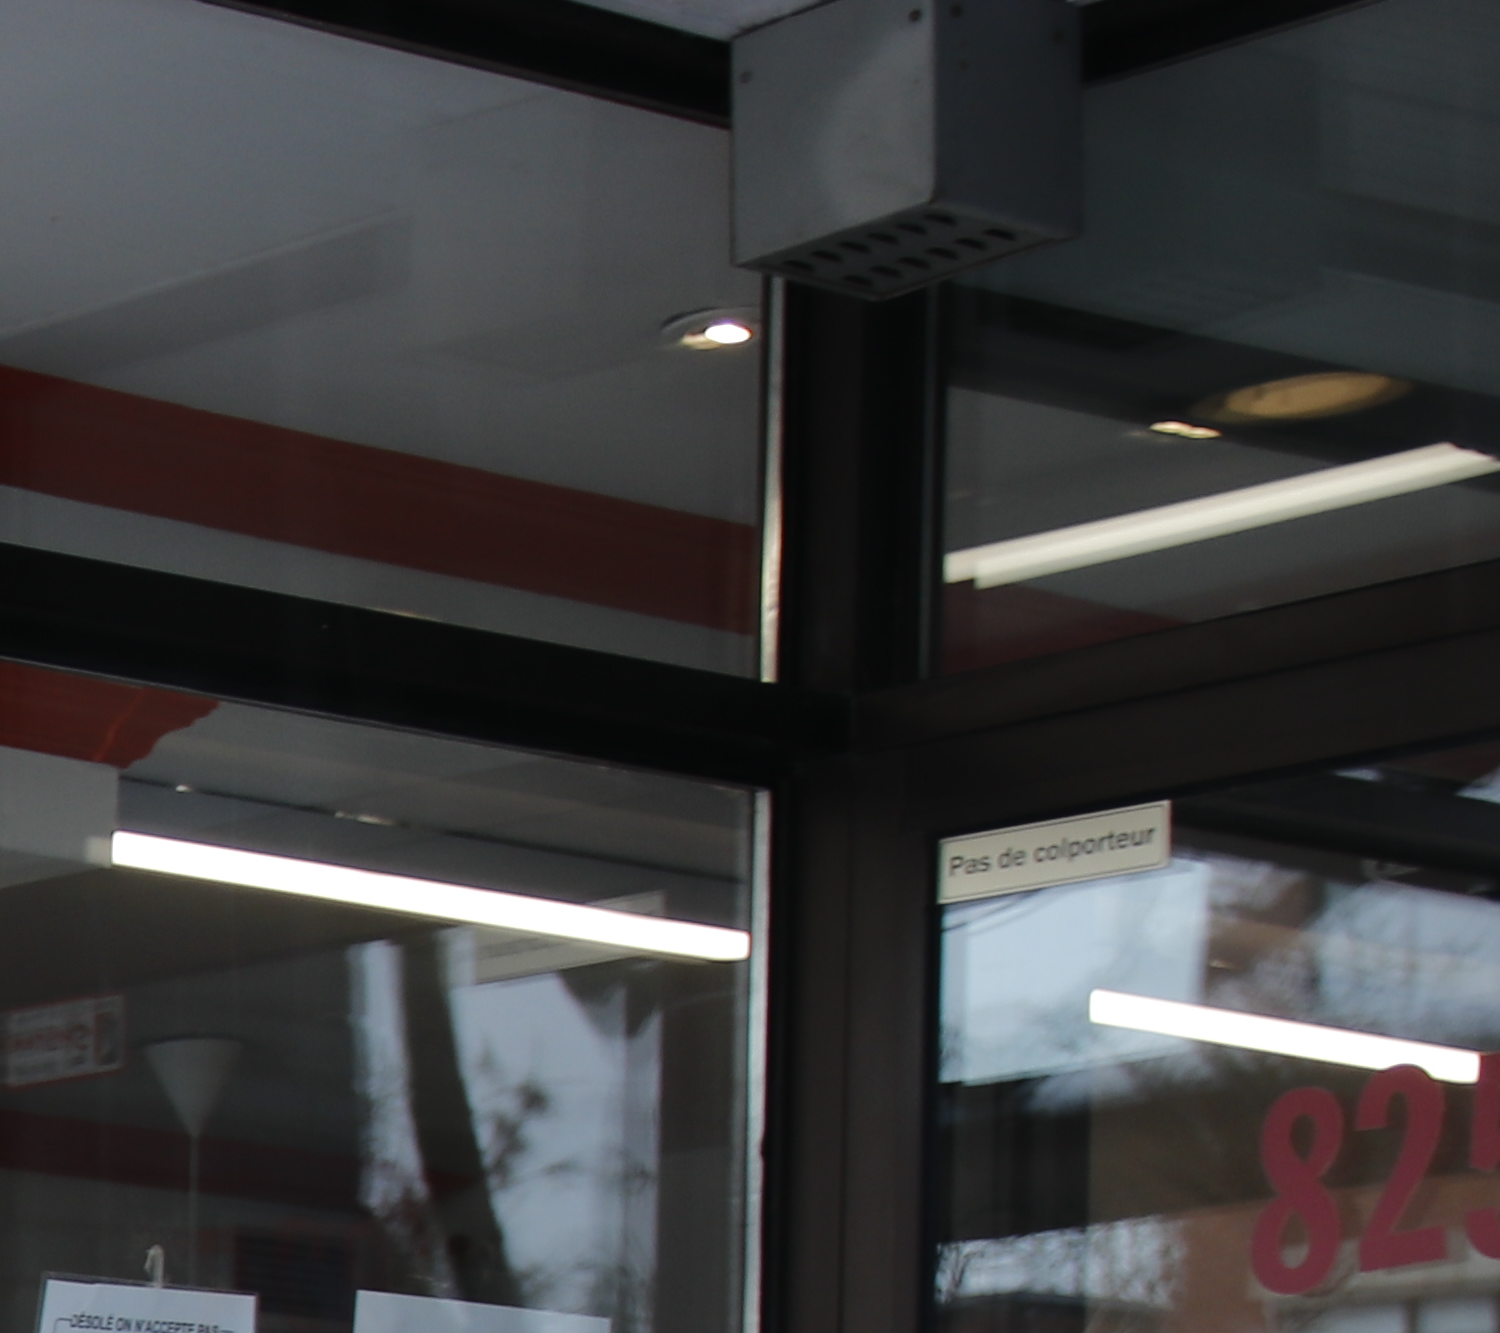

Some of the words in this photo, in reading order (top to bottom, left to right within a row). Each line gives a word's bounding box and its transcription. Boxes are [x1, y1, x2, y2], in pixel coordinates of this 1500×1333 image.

[949, 853, 990, 876] Pas
[998, 846, 1025, 869] de
[1033, 827, 1155, 863] colporteur
[70, 1312, 114, 1330] DÉSOLÉ
[116, 1318, 131, 1331] ON
